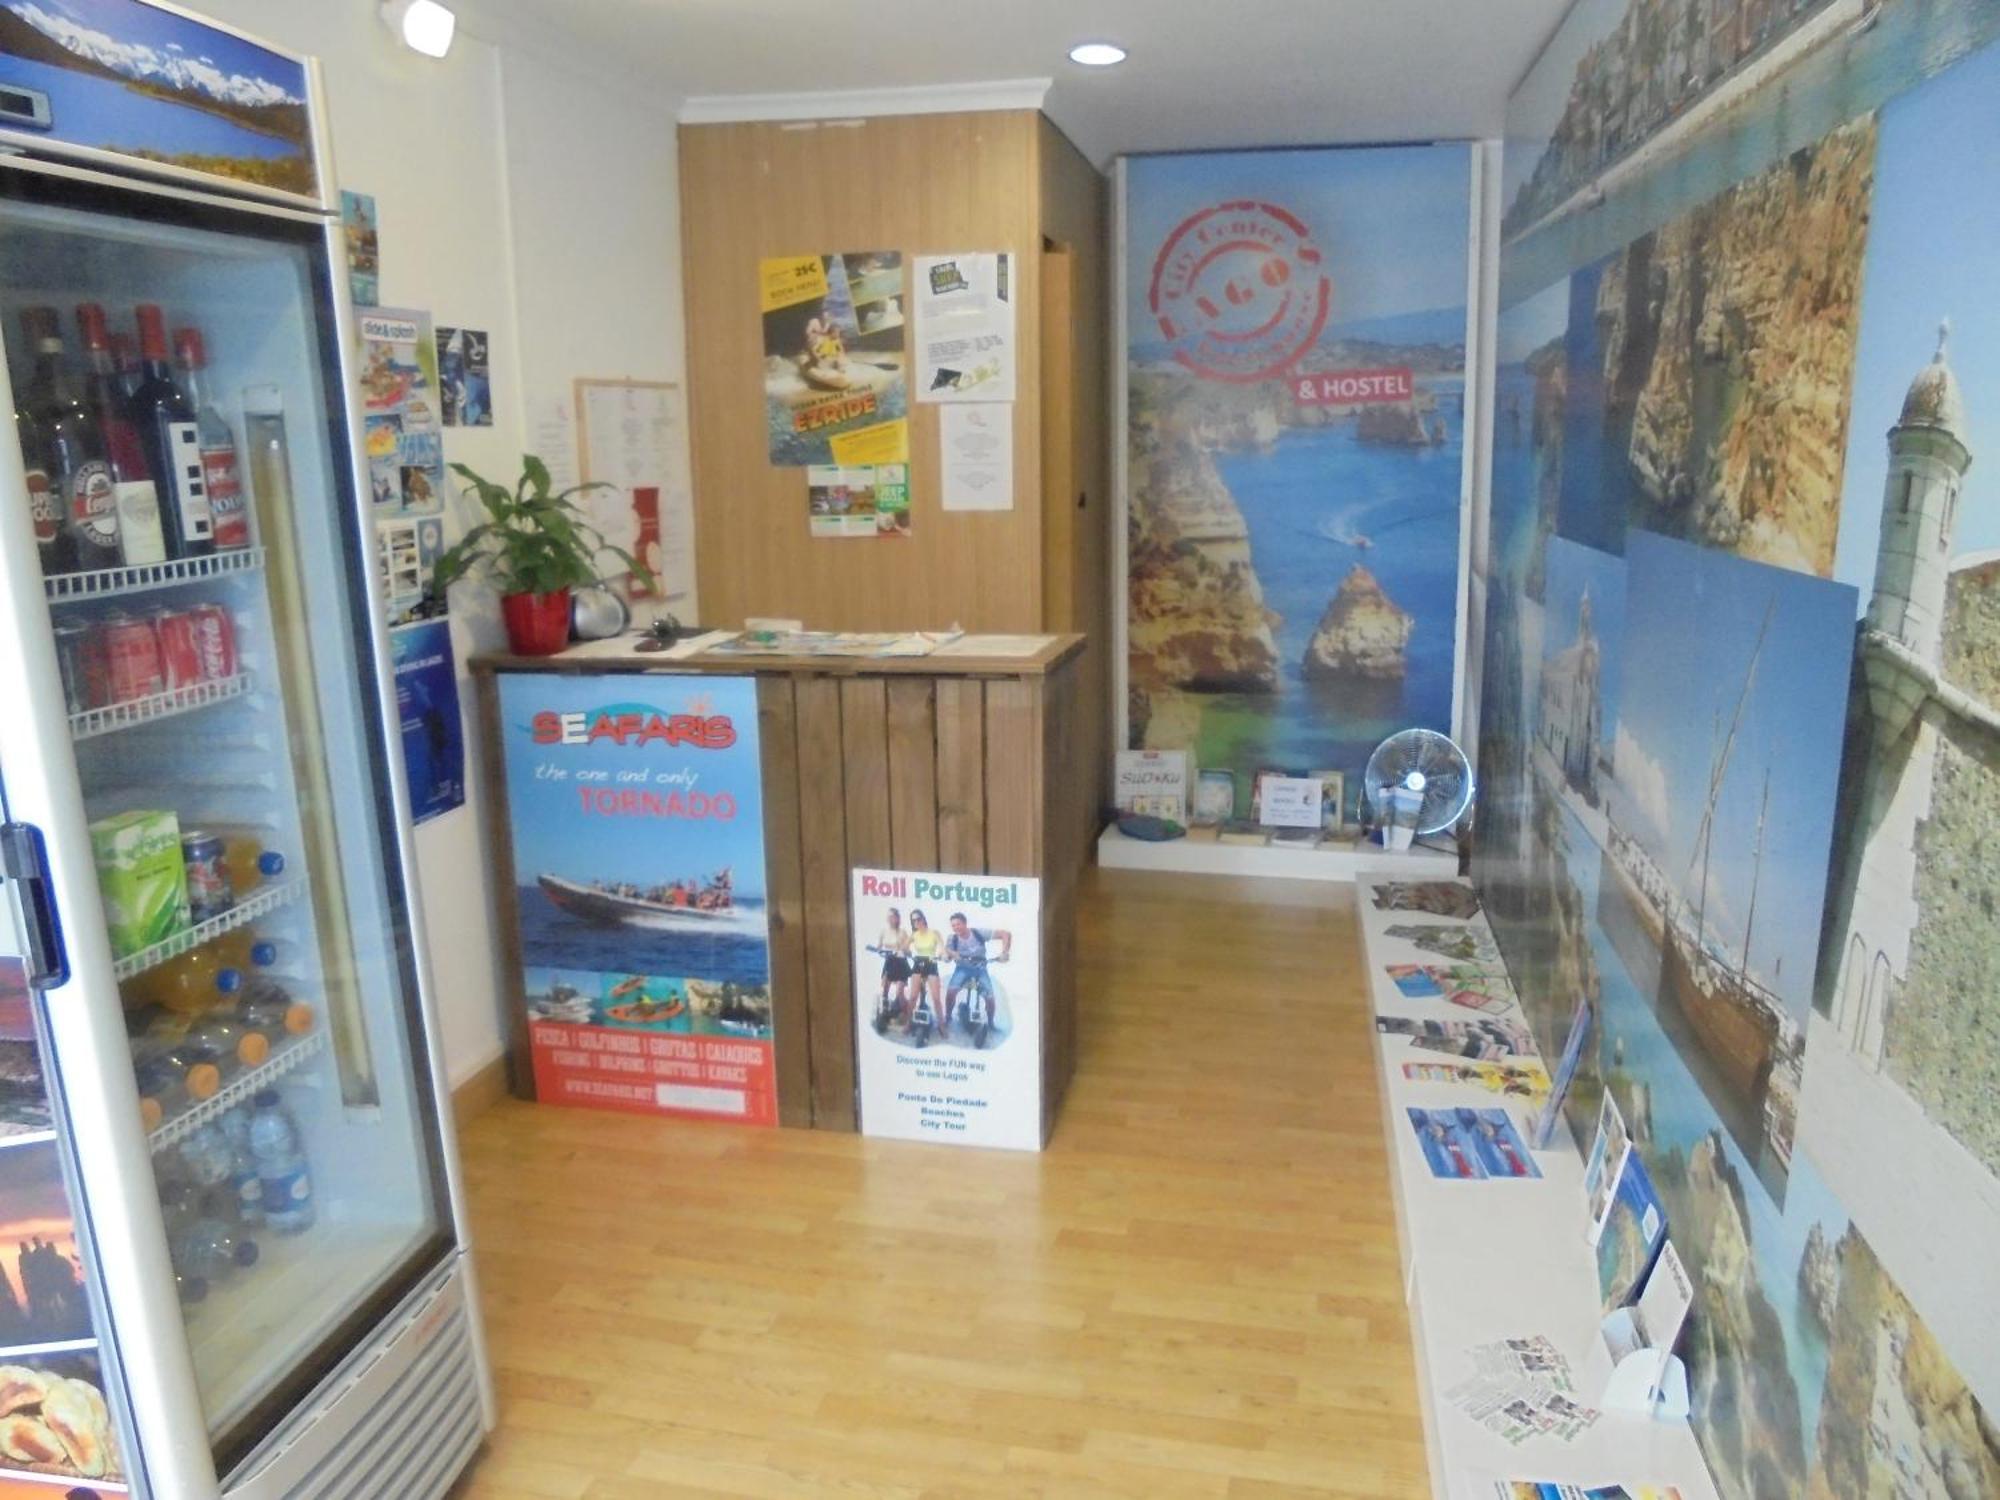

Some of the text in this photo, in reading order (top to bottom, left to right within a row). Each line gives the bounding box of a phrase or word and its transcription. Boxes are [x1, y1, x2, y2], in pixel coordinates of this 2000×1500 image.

[1299, 376, 1409, 399] & HOSTEL
[532, 711, 737, 750] SEAFARIS
[535, 762, 700, 790] the one and only
[578, 786, 737, 821] TORNADO
[862, 875, 1017, 907] Roll Portugal
[896, 1055, 986, 1072] Discover the FUN way
[943, 1071, 969, 1082] Lagos
[946, 1096, 988, 1107] Piedade
[920, 1106, 965, 1118] Beaches
[920, 1119, 966, 1131] City Tour
